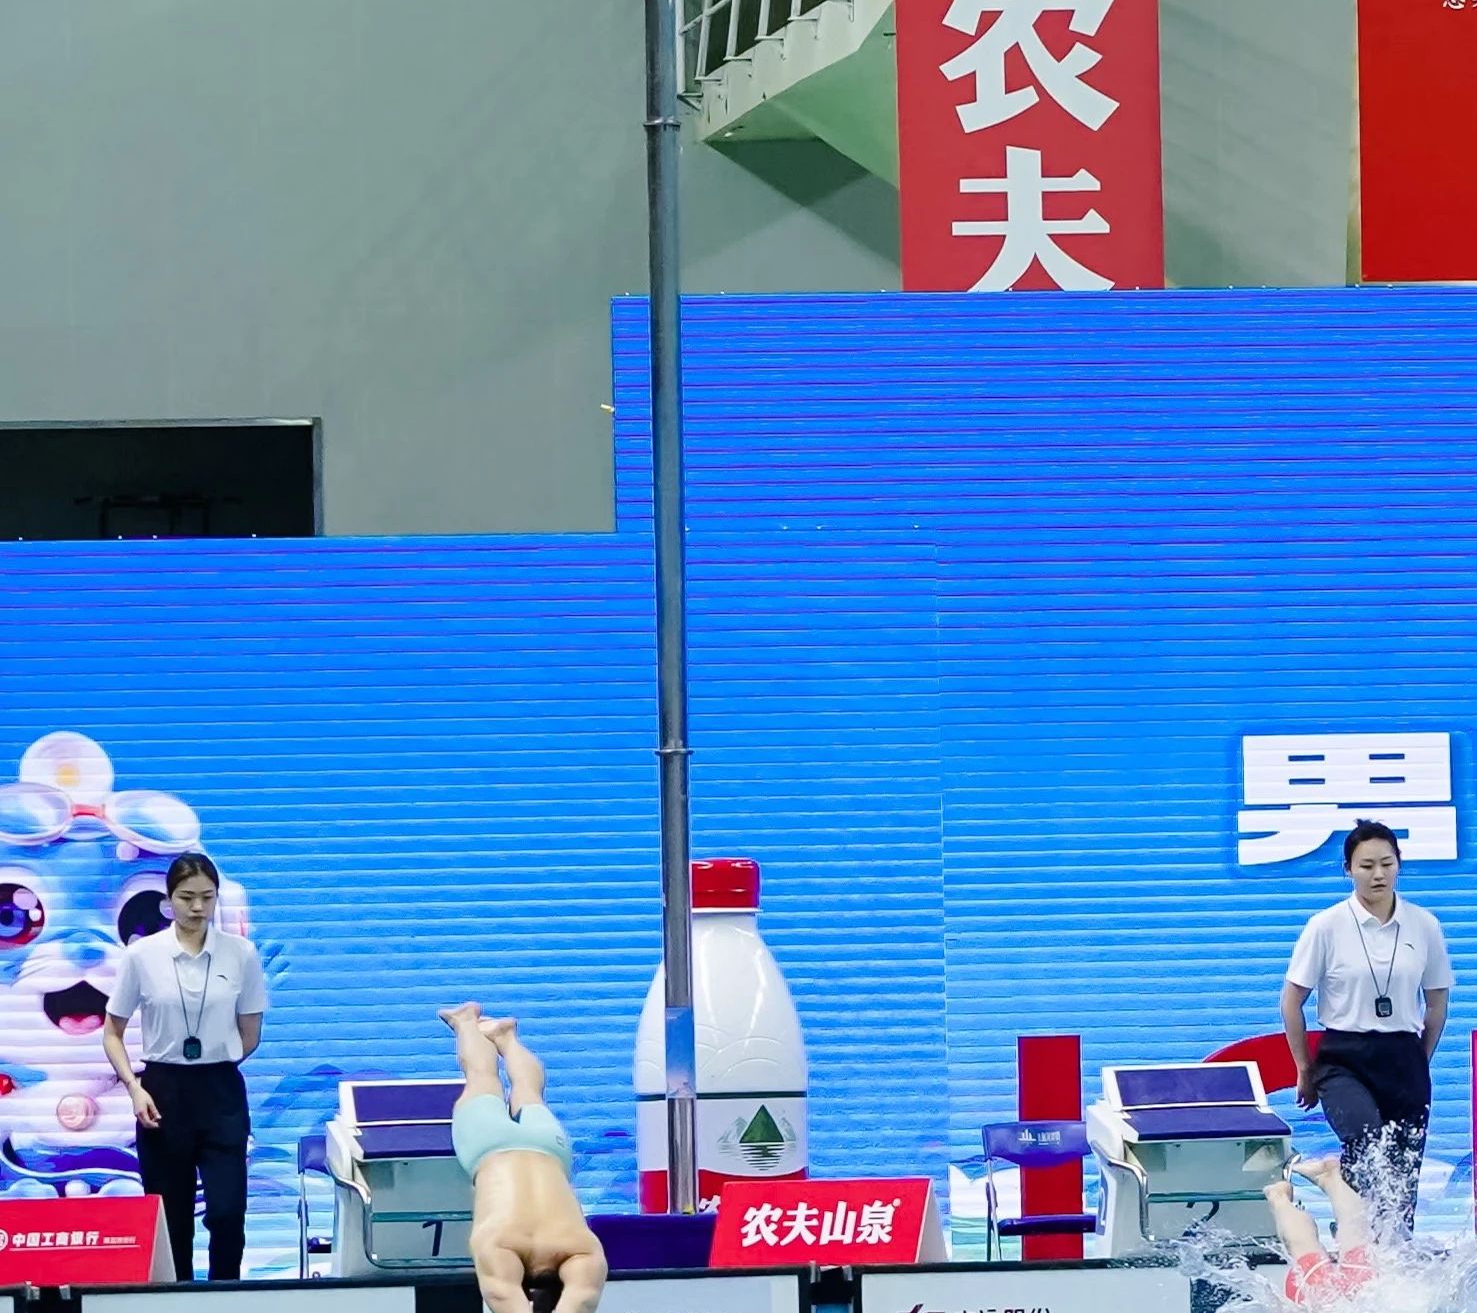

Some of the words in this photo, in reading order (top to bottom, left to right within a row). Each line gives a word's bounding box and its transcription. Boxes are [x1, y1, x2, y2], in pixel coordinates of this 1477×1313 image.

[11, 1230, 101, 1248] 中国工商银行
[740, 1199, 896, 1248] 农夫山泉
